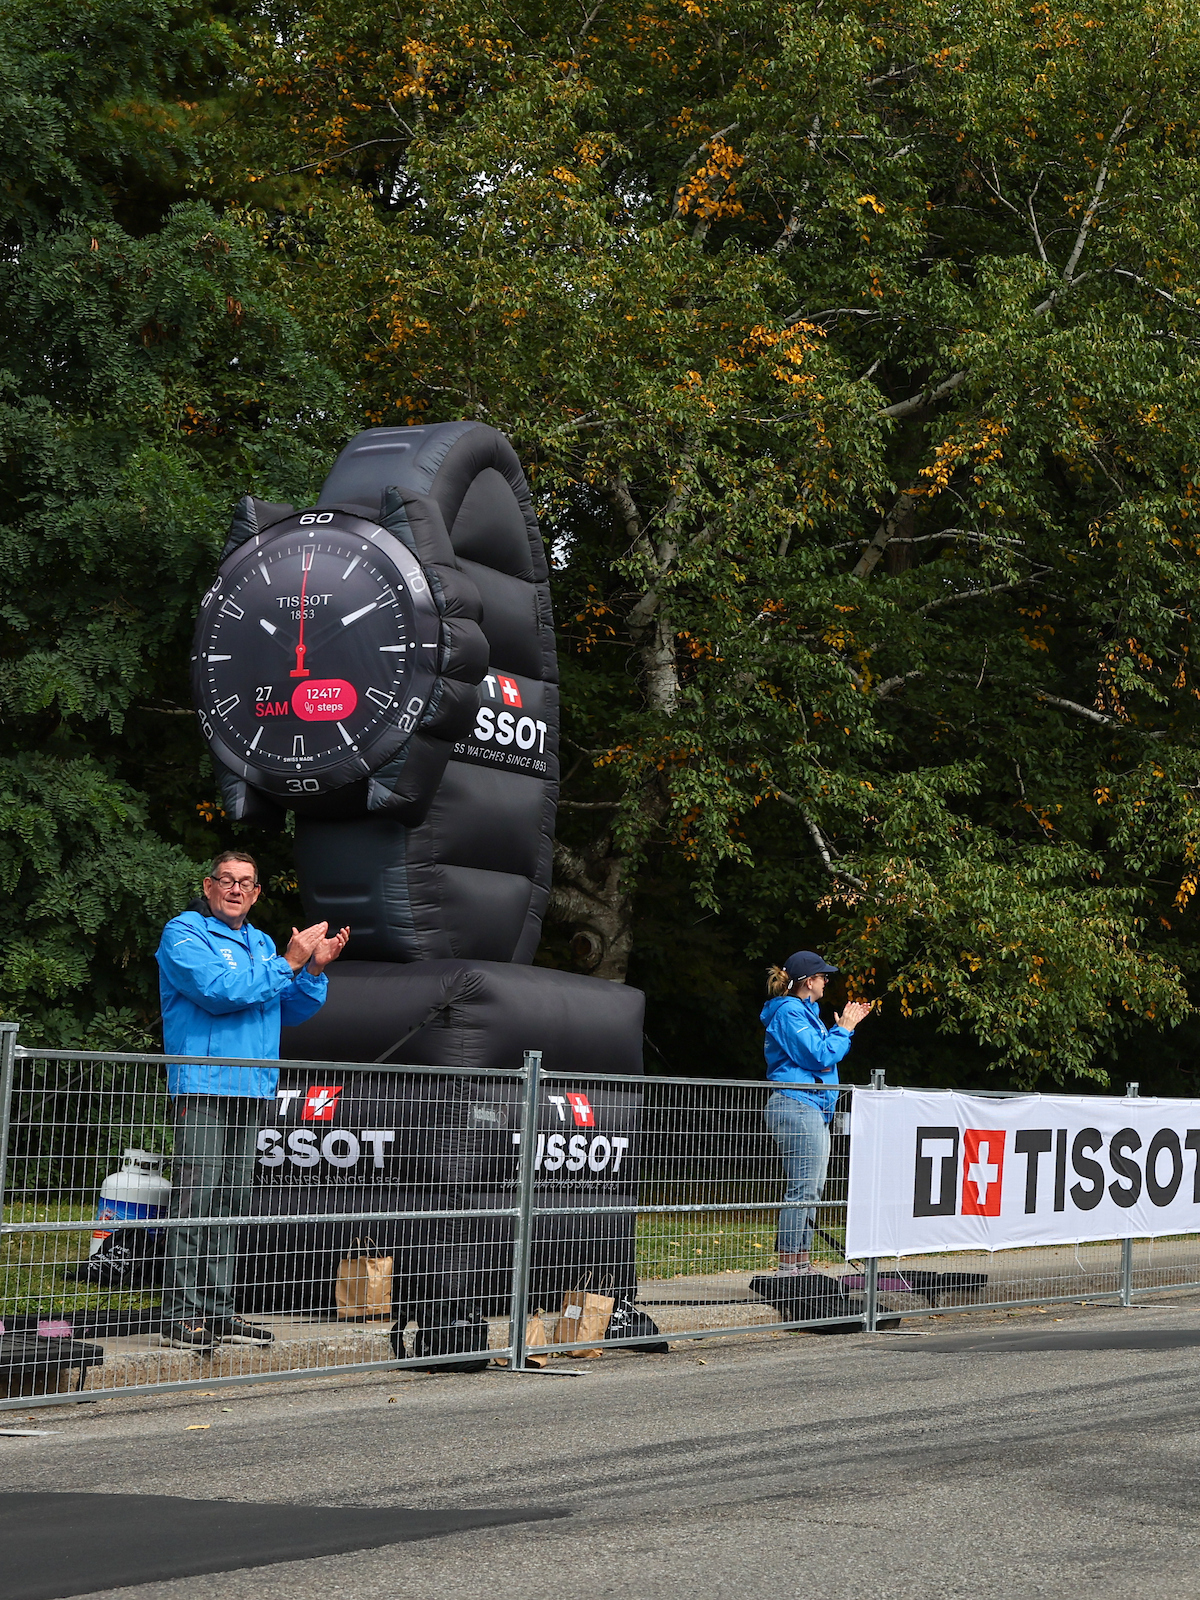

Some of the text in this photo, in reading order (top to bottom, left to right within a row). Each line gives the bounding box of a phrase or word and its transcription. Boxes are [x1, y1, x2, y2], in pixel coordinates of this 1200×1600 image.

[299, 512, 335, 526] 60
[200, 575, 223, 609] 50
[406, 566, 427, 594] 10
[276, 594, 333, 609] TISSOT
[290, 610, 315, 620] 1853
[255, 686, 342, 702] 27 12417
[255, 701, 343, 717] SAM steps
[398, 696, 424, 734] 20
[197, 708, 214, 740] 40
[473, 706, 547, 755] SSOT
[467, 745, 505, 763] WATCHES
[506, 753, 532, 768] SINCE
[532, 760, 547, 773] 1853
[285, 778, 320, 792] 30
[256, 1128, 396, 1169] SSOT
